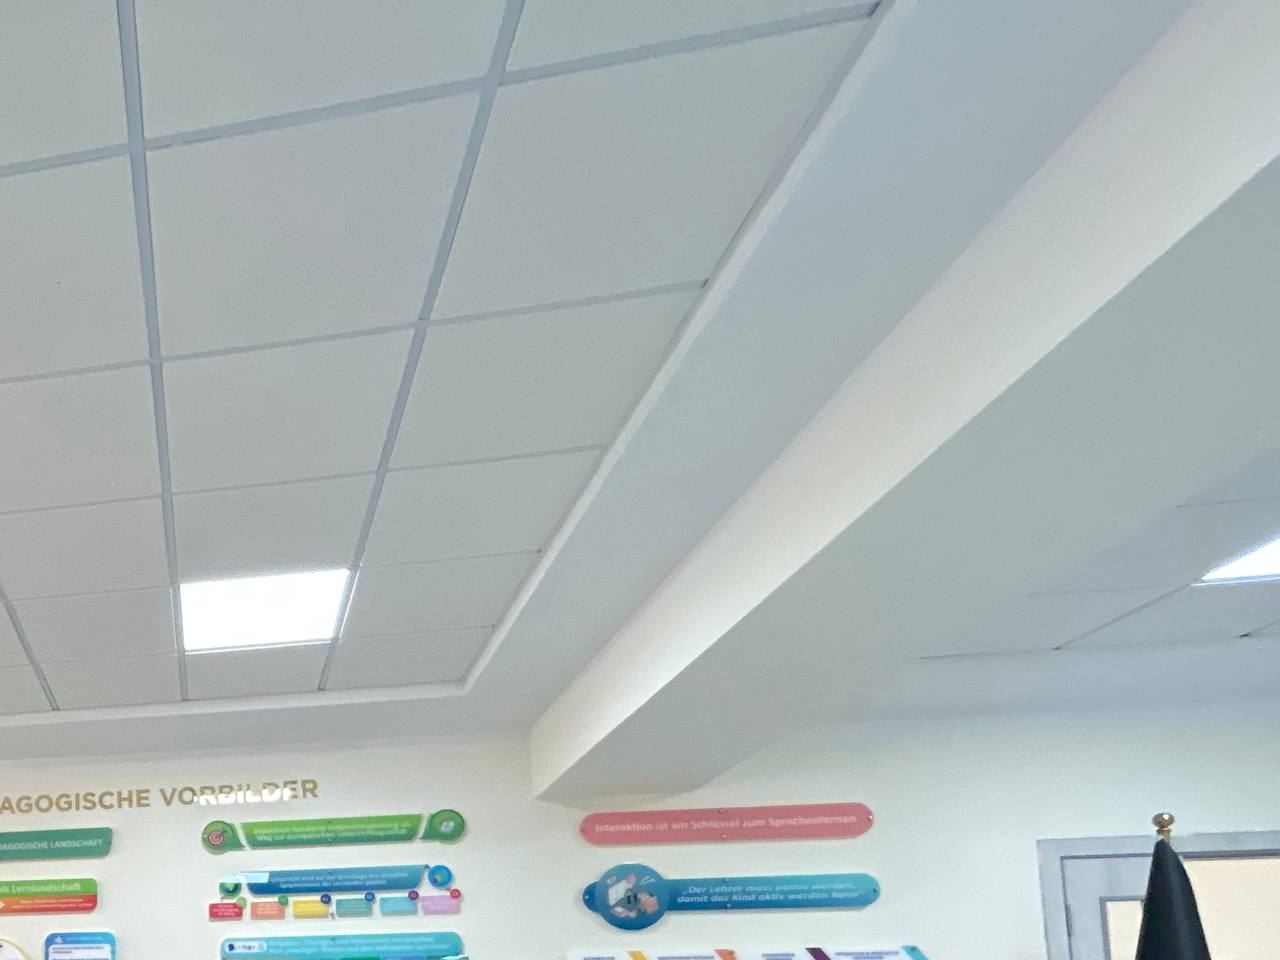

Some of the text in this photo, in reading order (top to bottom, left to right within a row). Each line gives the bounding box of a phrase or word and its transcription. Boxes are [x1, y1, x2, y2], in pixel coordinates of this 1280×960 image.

[159, 779, 318, 808] VORBILDER
[595, 814, 858, 833] Interaktion ist ein Schlüssel zum Sprachenlernen
[50, 838, 103, 849] LANDSCHAFT
[710, 884, 743, 894] Lehrer
[676, 894, 708, 904] damit
[711, 893, 729, 903] das
[732, 892, 756, 902] Kind
[758, 891, 786, 901] aktiv
[787, 891, 828, 900] werden
